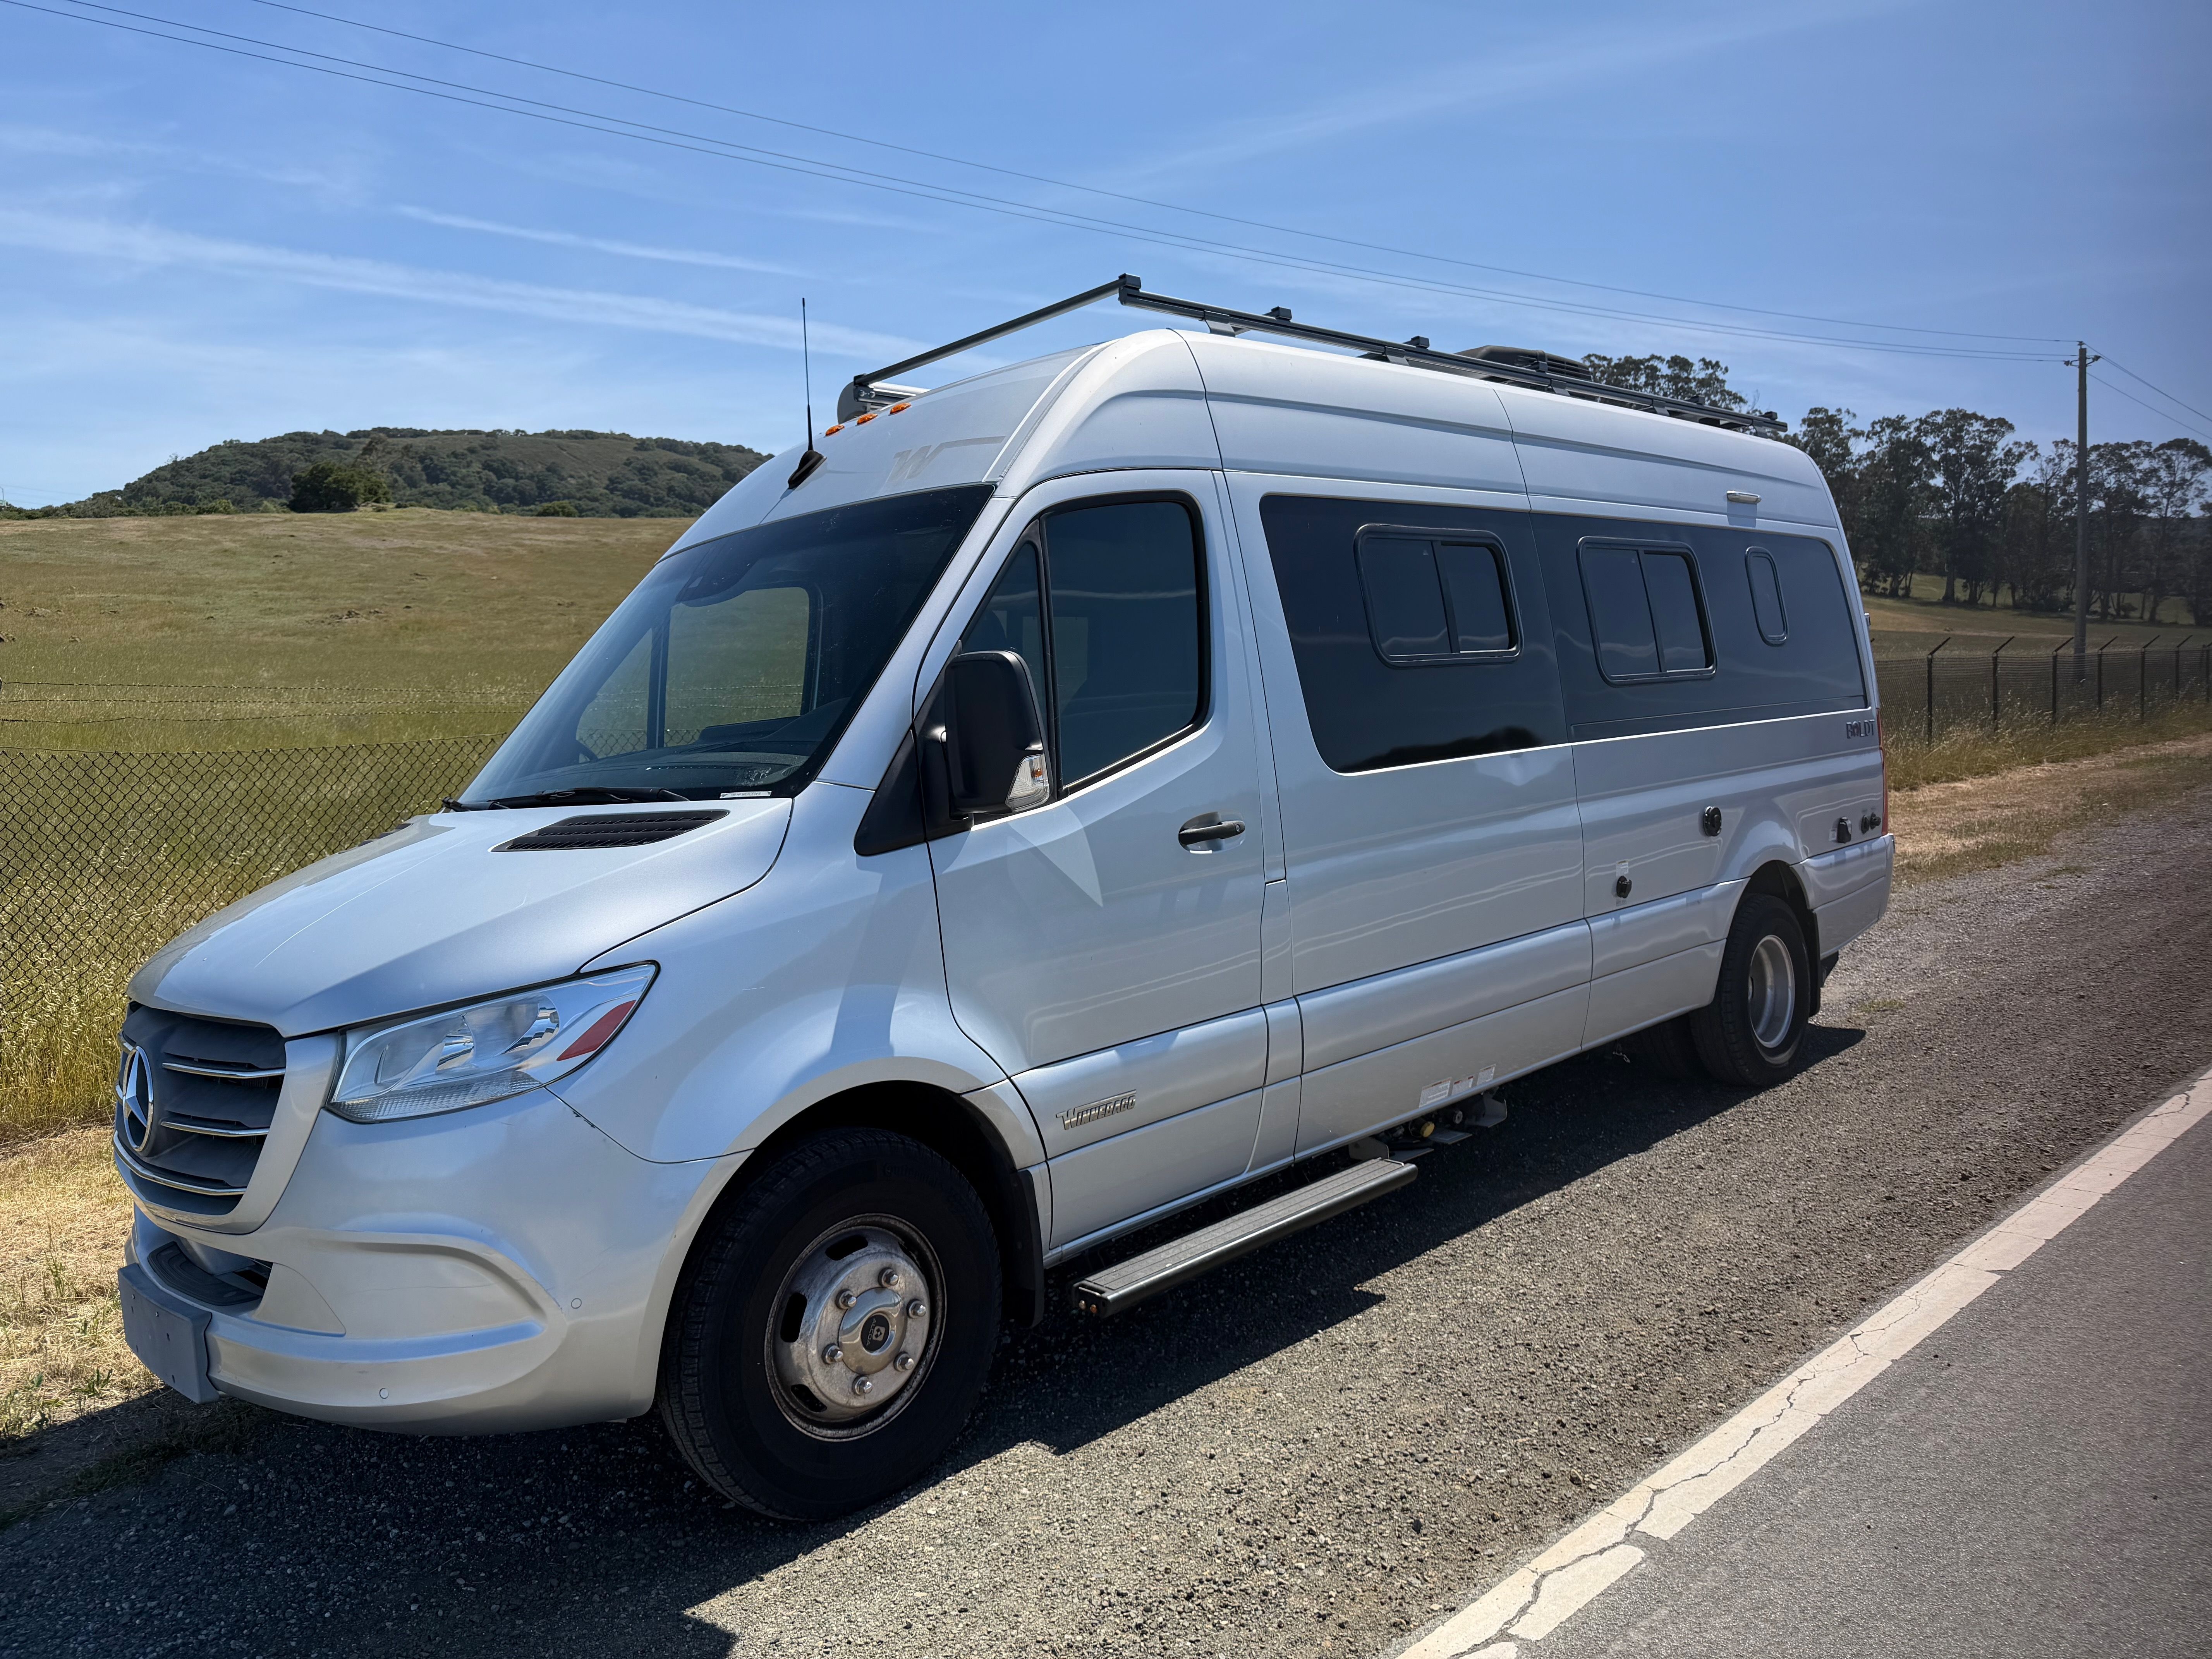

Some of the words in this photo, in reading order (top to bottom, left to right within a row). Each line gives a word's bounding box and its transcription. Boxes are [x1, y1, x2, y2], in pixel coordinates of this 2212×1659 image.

[1846, 719, 1875, 739] BOLDT
[1056, 1089, 1137, 1130] WINNEBAGO
[866, 1318, 877, 1346] ALCOA
